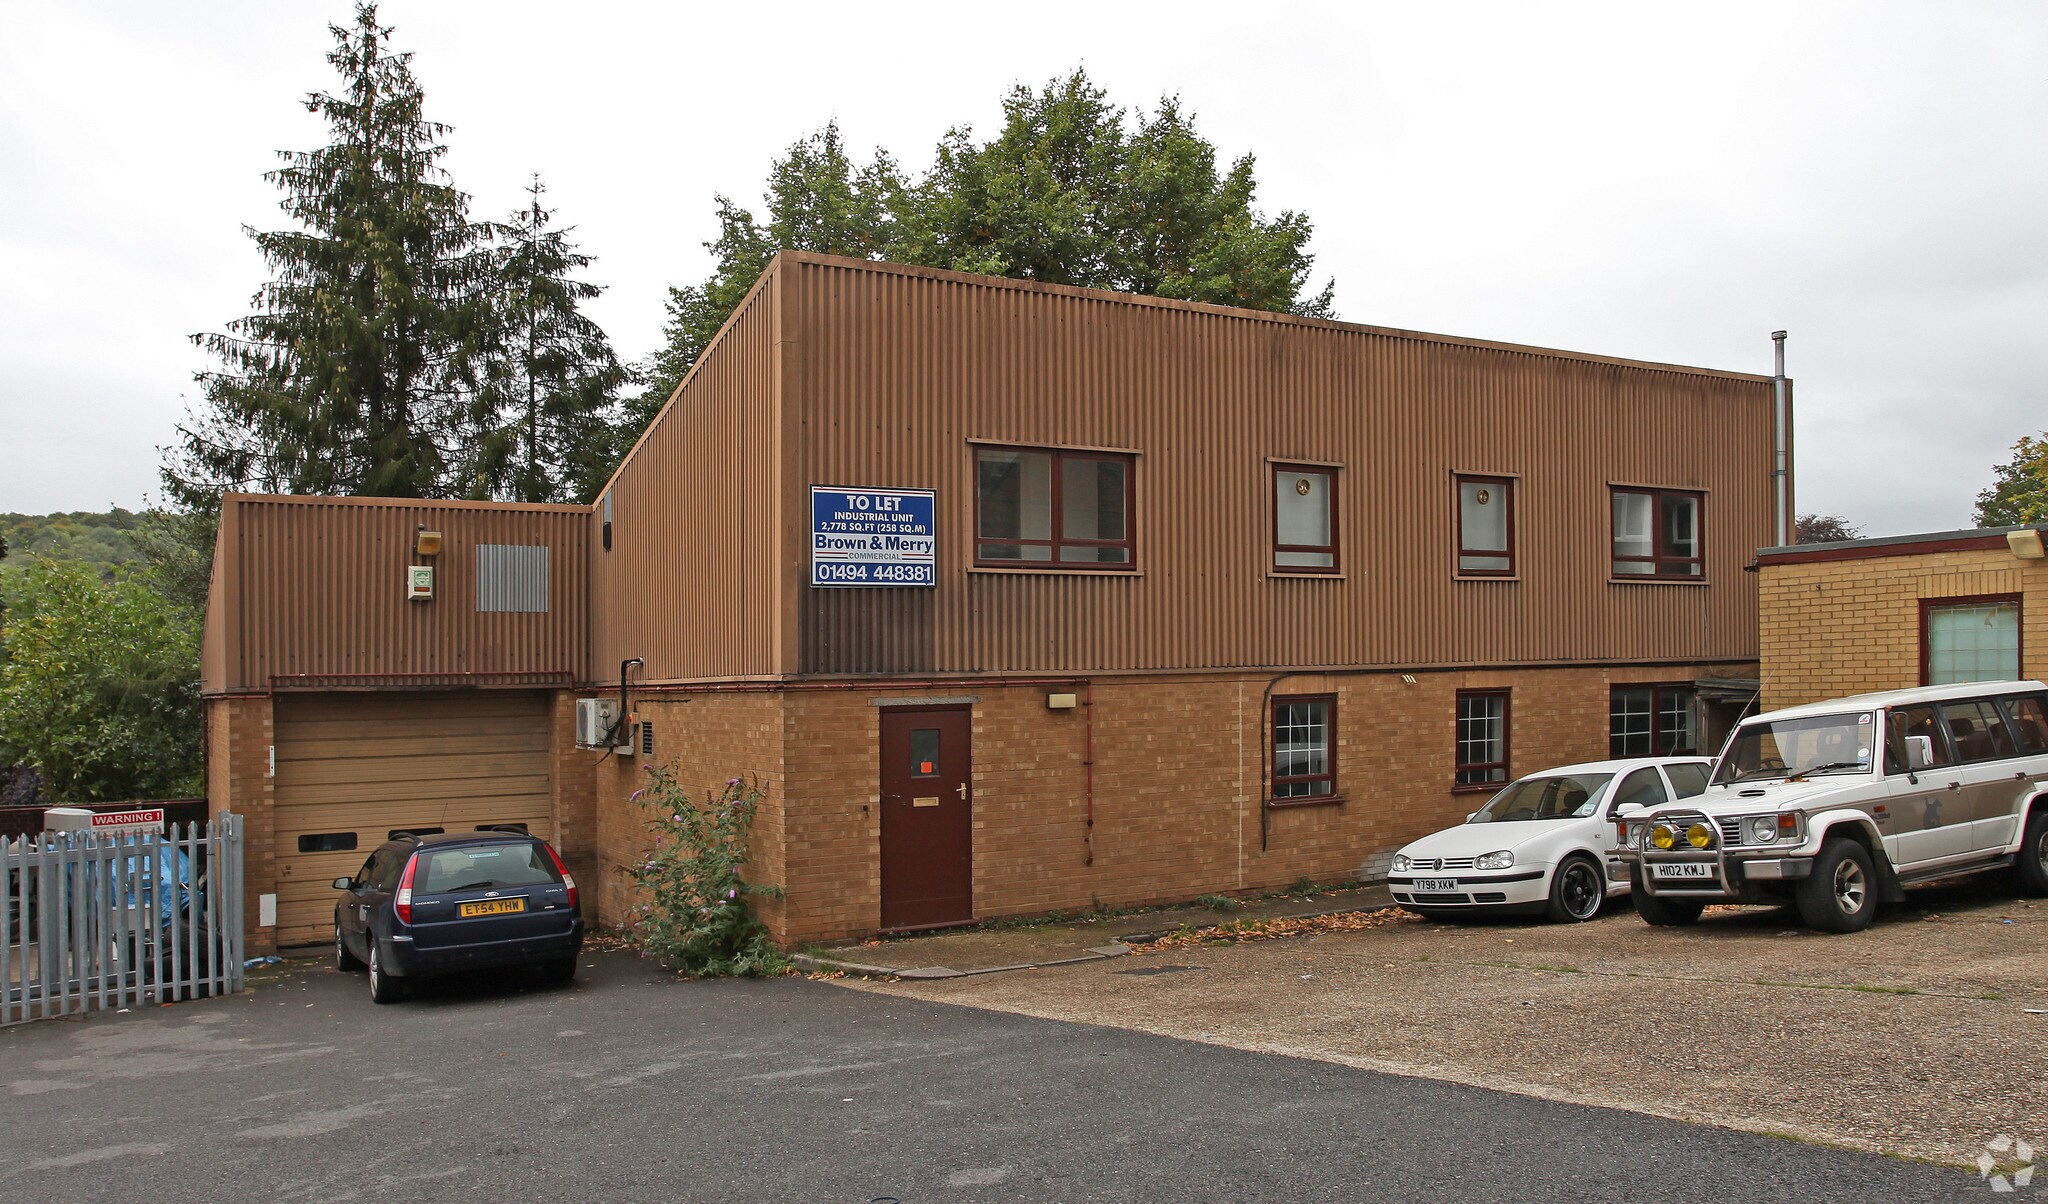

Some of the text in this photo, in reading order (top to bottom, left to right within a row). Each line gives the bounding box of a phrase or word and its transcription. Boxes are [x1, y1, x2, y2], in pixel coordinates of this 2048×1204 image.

[847, 495, 902, 511] TO LET
[834, 511, 914, 523] INDUSTRIAL UNIT
[821, 522, 926, 534] 2,778 SQ.FT (258 SQ.M)
[815, 534, 933, 554] Brown & Merry
[848, 552, 901, 561] COMMERCIAL
[818, 564, 931, 581] 01494 448381
[94, 812, 153, 825] WARNING
[1658, 865, 1705, 876] H102 KMJ
[1416, 880, 1455, 890] Y798 XKM
[465, 900, 519, 915] ET54 YHW
